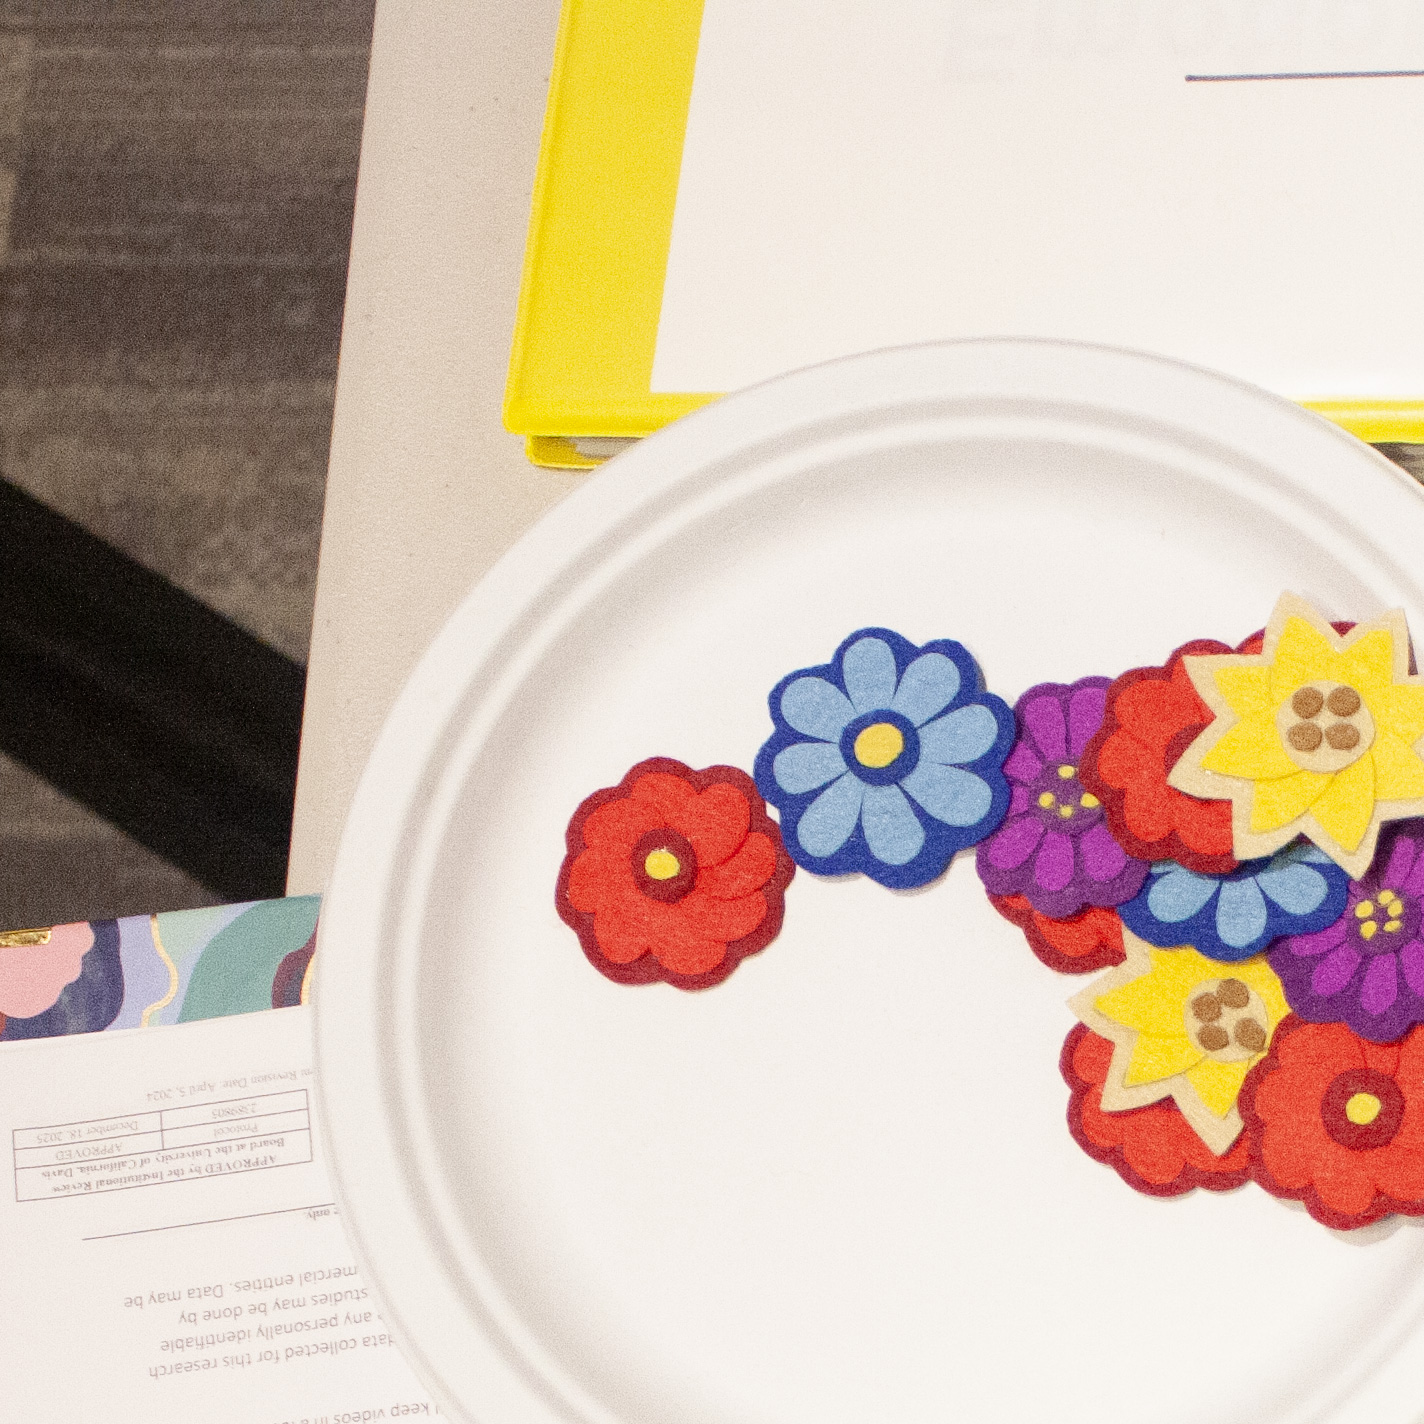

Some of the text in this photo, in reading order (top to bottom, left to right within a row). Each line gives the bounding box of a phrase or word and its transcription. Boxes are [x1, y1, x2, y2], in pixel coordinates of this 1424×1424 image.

[86, 1120, 138, 1137] December
[212, 1121, 258, 1136] Protocol
[36, 1130, 63, 1144] 2025
[249, 1136, 285, 1151] Board
[54, 1141, 123, 1160] APPROVED
[214, 1145, 232, 1156] the
[235, 1142, 246, 1152] at
[138, 1156, 150, 1167] of
[154, 1146, 211, 1165] University
[41, 1167, 72, 1180] Davis
[51, 1154, 277, 1195] APPROVED by the Institutional Review
[178, 1287, 369, 1326] studies may be done by
[333, 1408, 386, 1424] videos
[390, 1402, 430, 1417] keep
